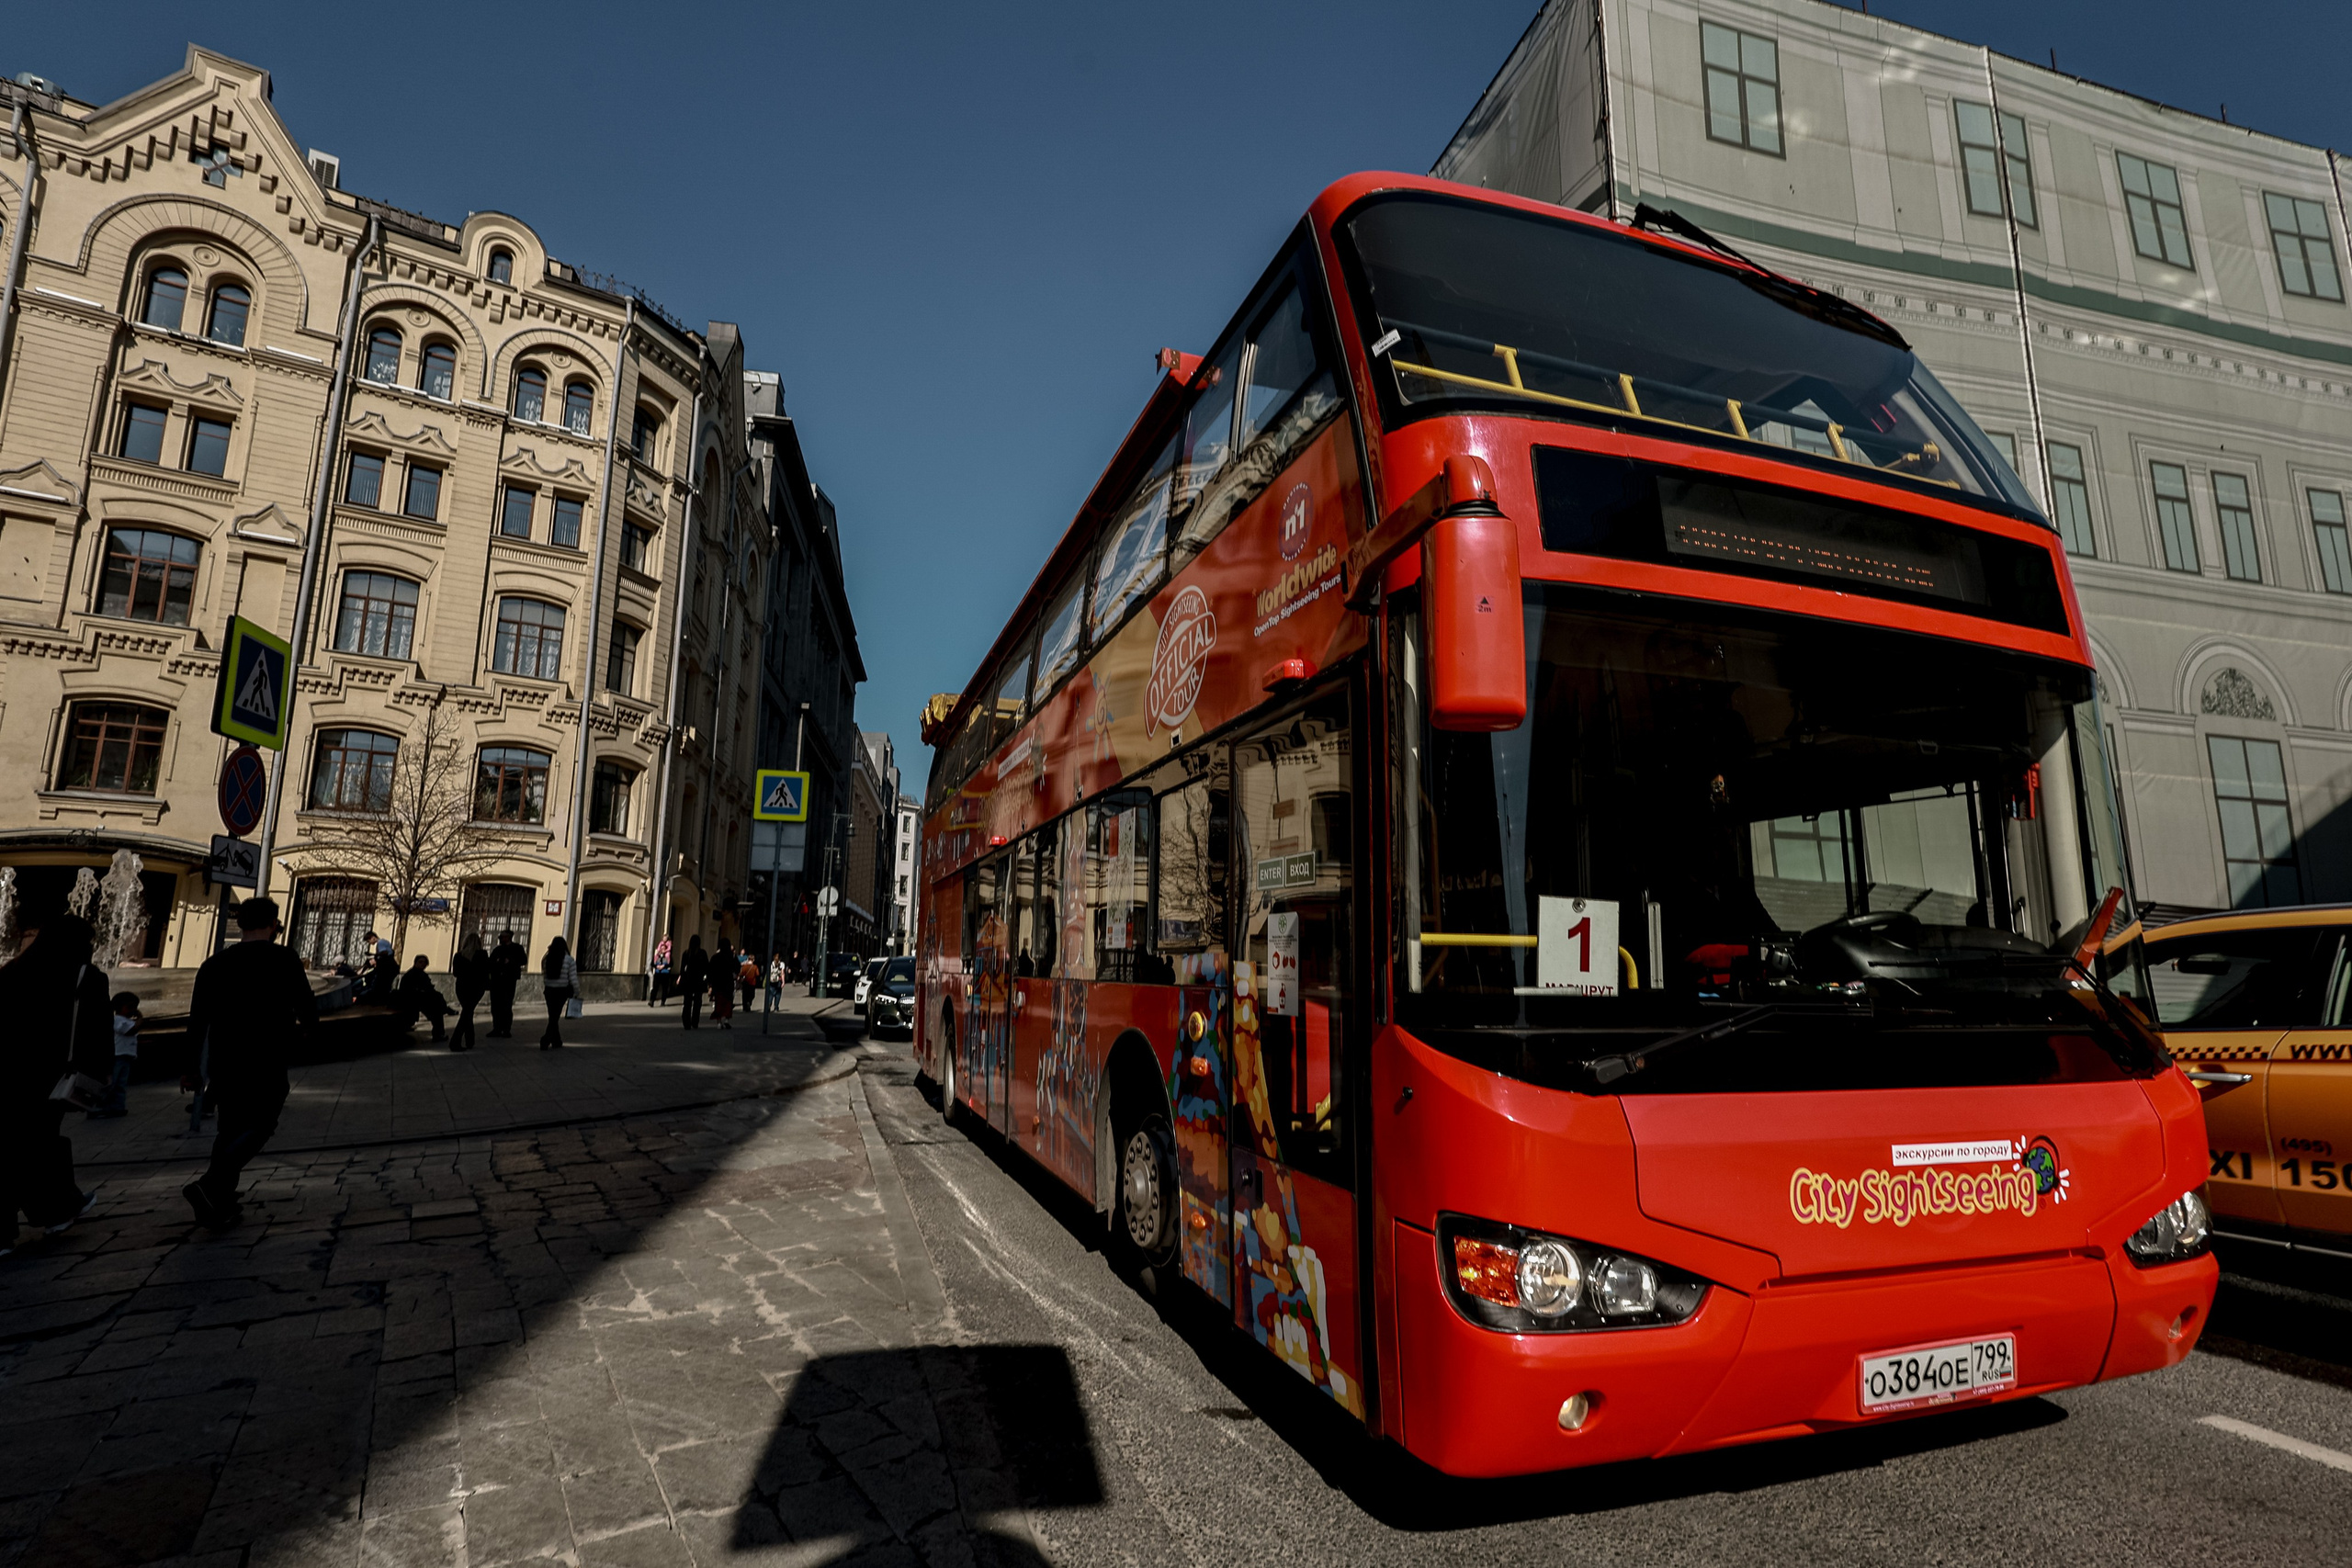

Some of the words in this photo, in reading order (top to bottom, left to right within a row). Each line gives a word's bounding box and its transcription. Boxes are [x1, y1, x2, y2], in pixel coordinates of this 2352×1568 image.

[1257, 543, 1337, 617] Worldwide
[1281, 588, 1319, 619] Sightseeing
[1321, 572, 1341, 593] Tours
[1159, 629, 1170, 655] CITY
[1169, 594, 1201, 630] SIGHTSEEING
[1149, 617, 1214, 717] OFFICIAL
[1172, 666, 1200, 714] TOUR
[1260, 866, 1282, 881] ENTER
[1290, 862, 1310, 877] ВХОД
[1567, 916, 1591, 973] 1
[2290, 1043, 2352, 1060] ww
[1895, 1148, 1954, 1161] экскурсии
[1957, 1146, 1971, 1156] по
[1973, 1145, 2009, 1157] городу
[2210, 1149, 2253, 1180] XI
[1860, 1164, 2038, 1228] Sightseeing
[1973, 1340, 2008, 1372] 799
[1982, 1370, 2000, 1382] RUS
